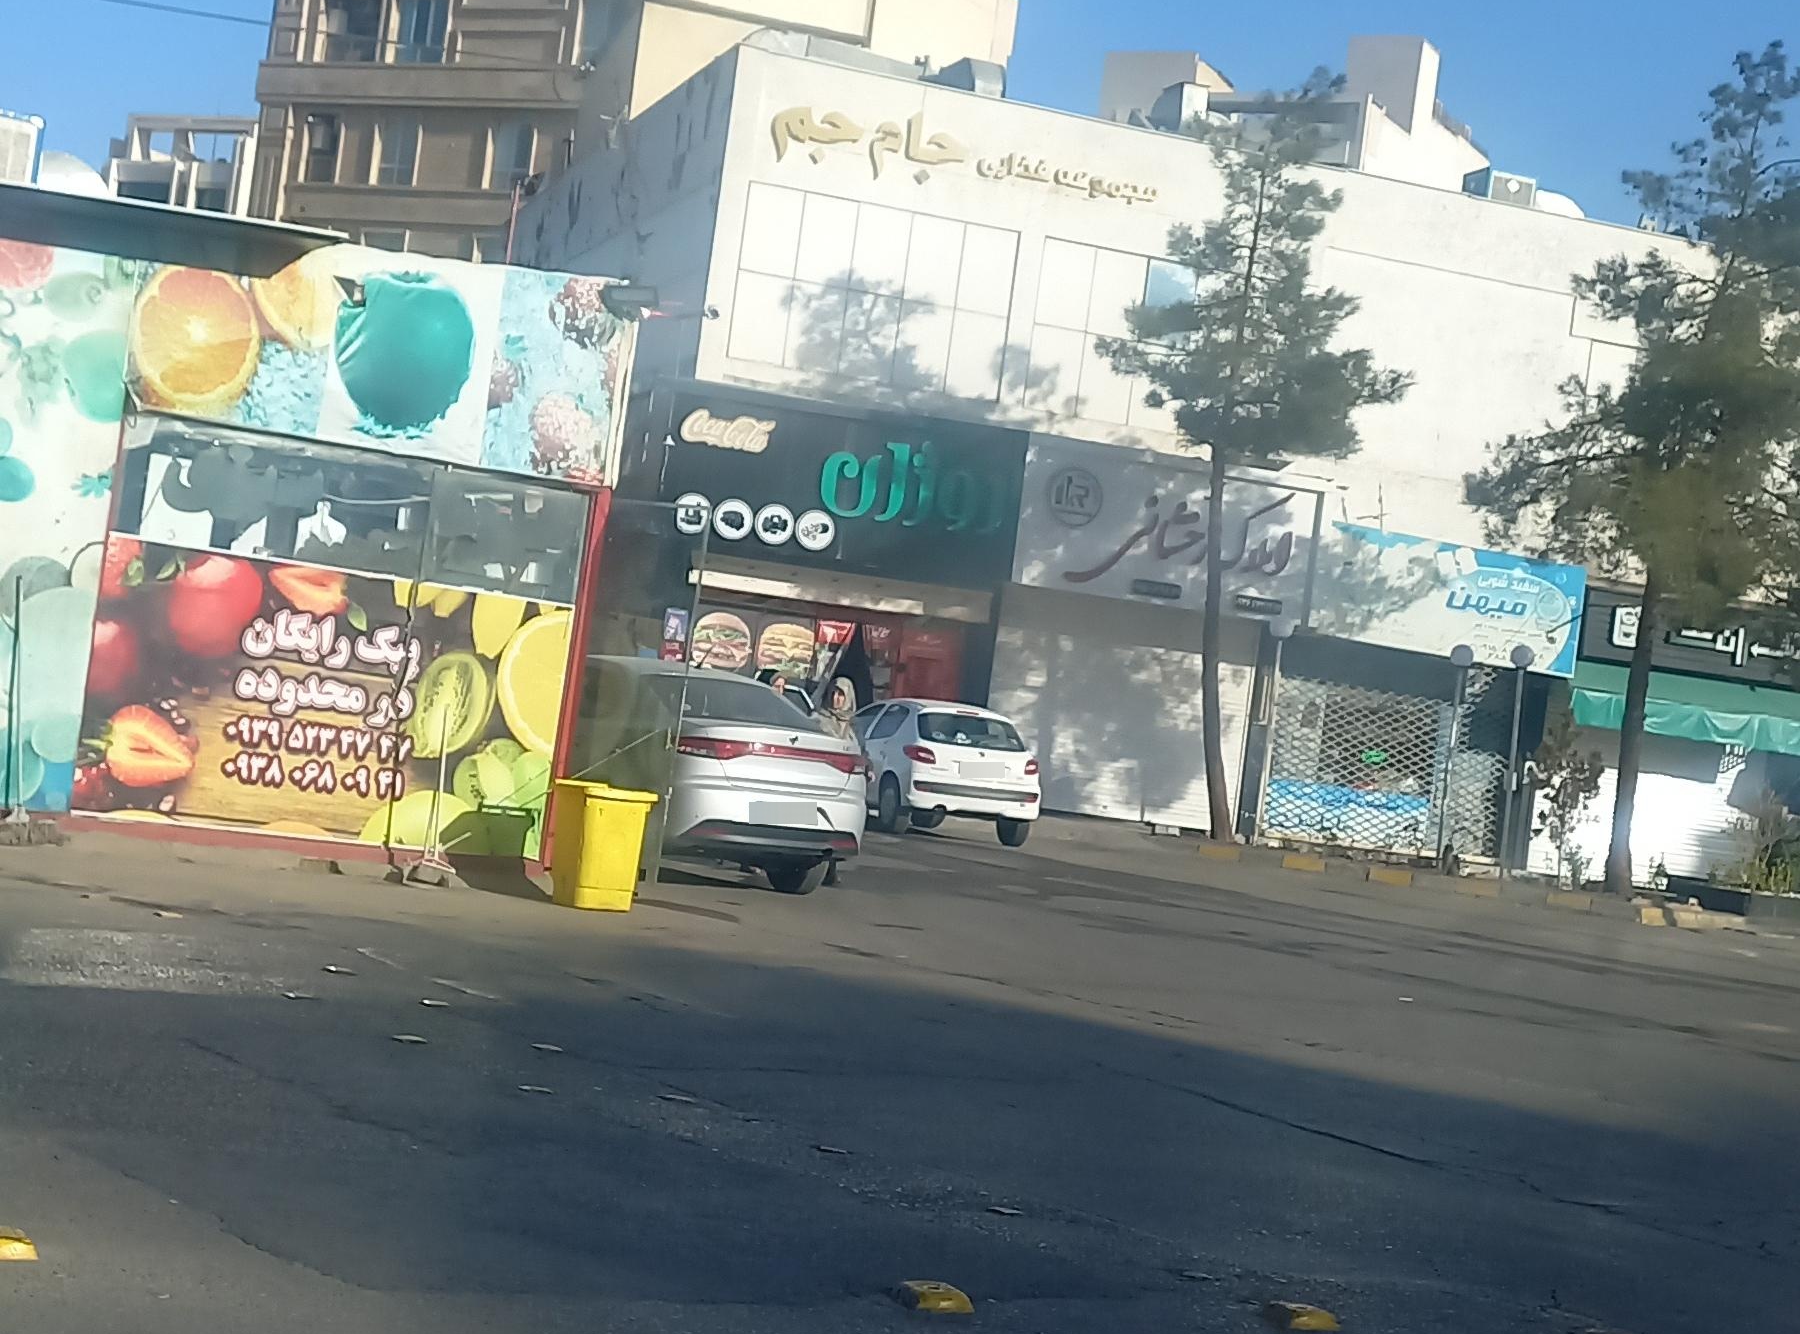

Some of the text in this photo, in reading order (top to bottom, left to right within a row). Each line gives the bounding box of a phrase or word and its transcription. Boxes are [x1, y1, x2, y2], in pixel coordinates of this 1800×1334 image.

[770, 104, 1157, 205] مجموعه غذایی جام جم
[1445, 586, 1528, 619] میهن
[235, 667, 366, 716] محدوده
[224, 716, 281, 748] ۰۹۳۹
[223, 752, 282, 784] ۰۹۳۸
